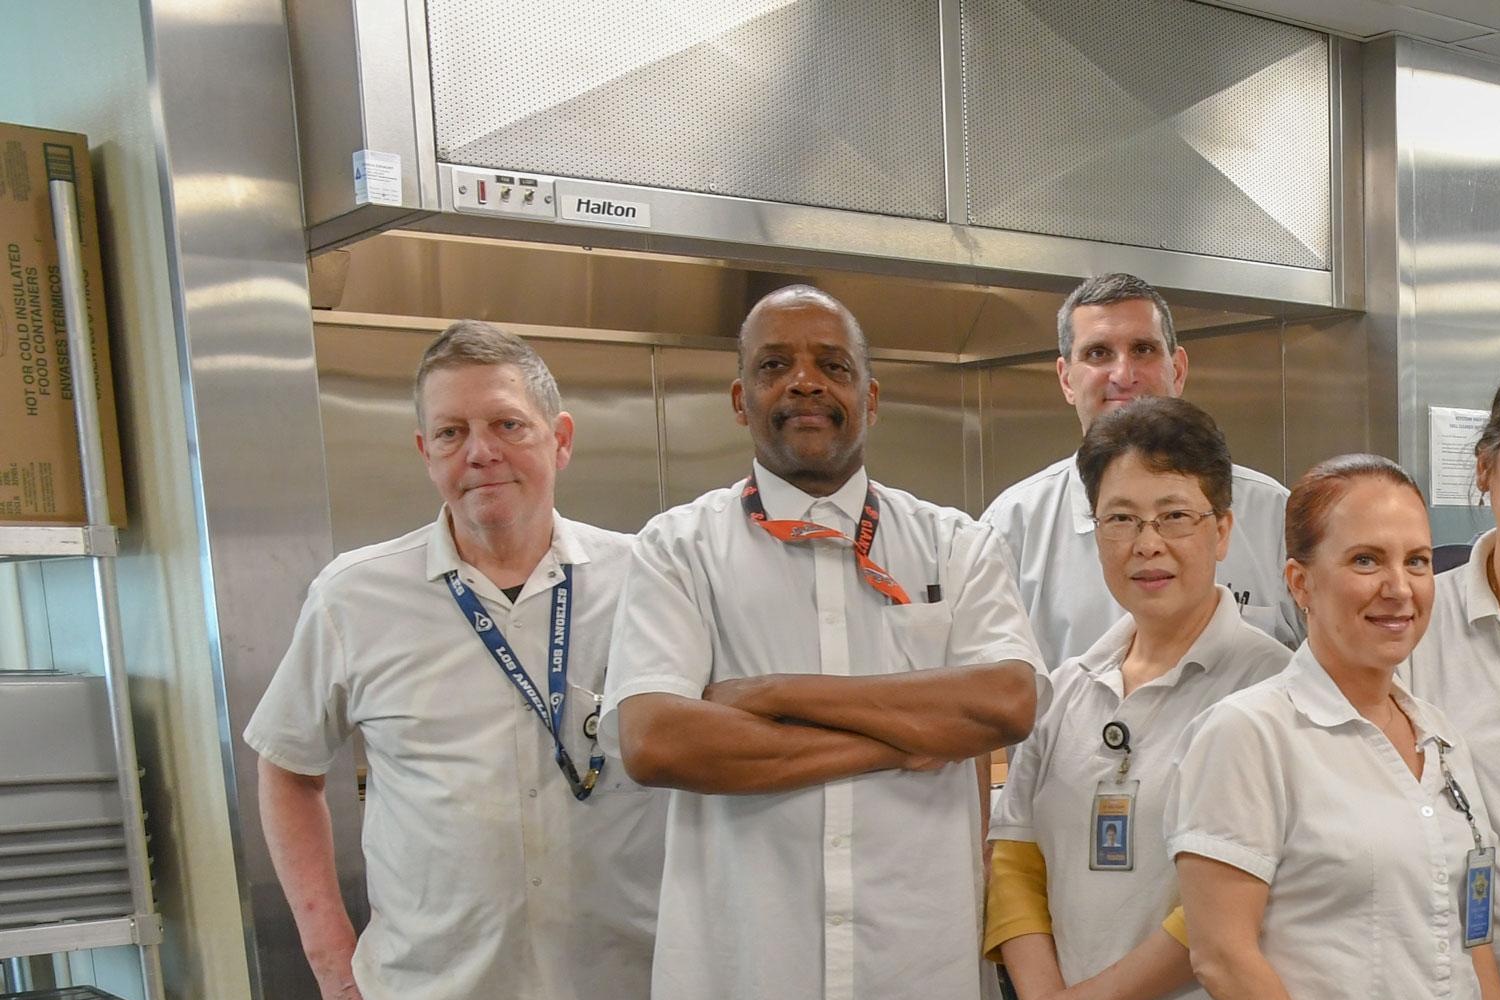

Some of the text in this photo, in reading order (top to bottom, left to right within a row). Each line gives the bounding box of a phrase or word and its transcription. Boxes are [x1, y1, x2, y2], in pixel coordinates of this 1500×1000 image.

[576, 198, 636, 218] Halton
[8, 243, 38, 416] HOT OR COLD INSULATED
[25, 266, 50, 397] FOOD CONTAINERS
[56, 338, 73, 401] ENVASES
[496, 646, 517, 671] LOS
[553, 587, 568, 672] LOS ANGELES
